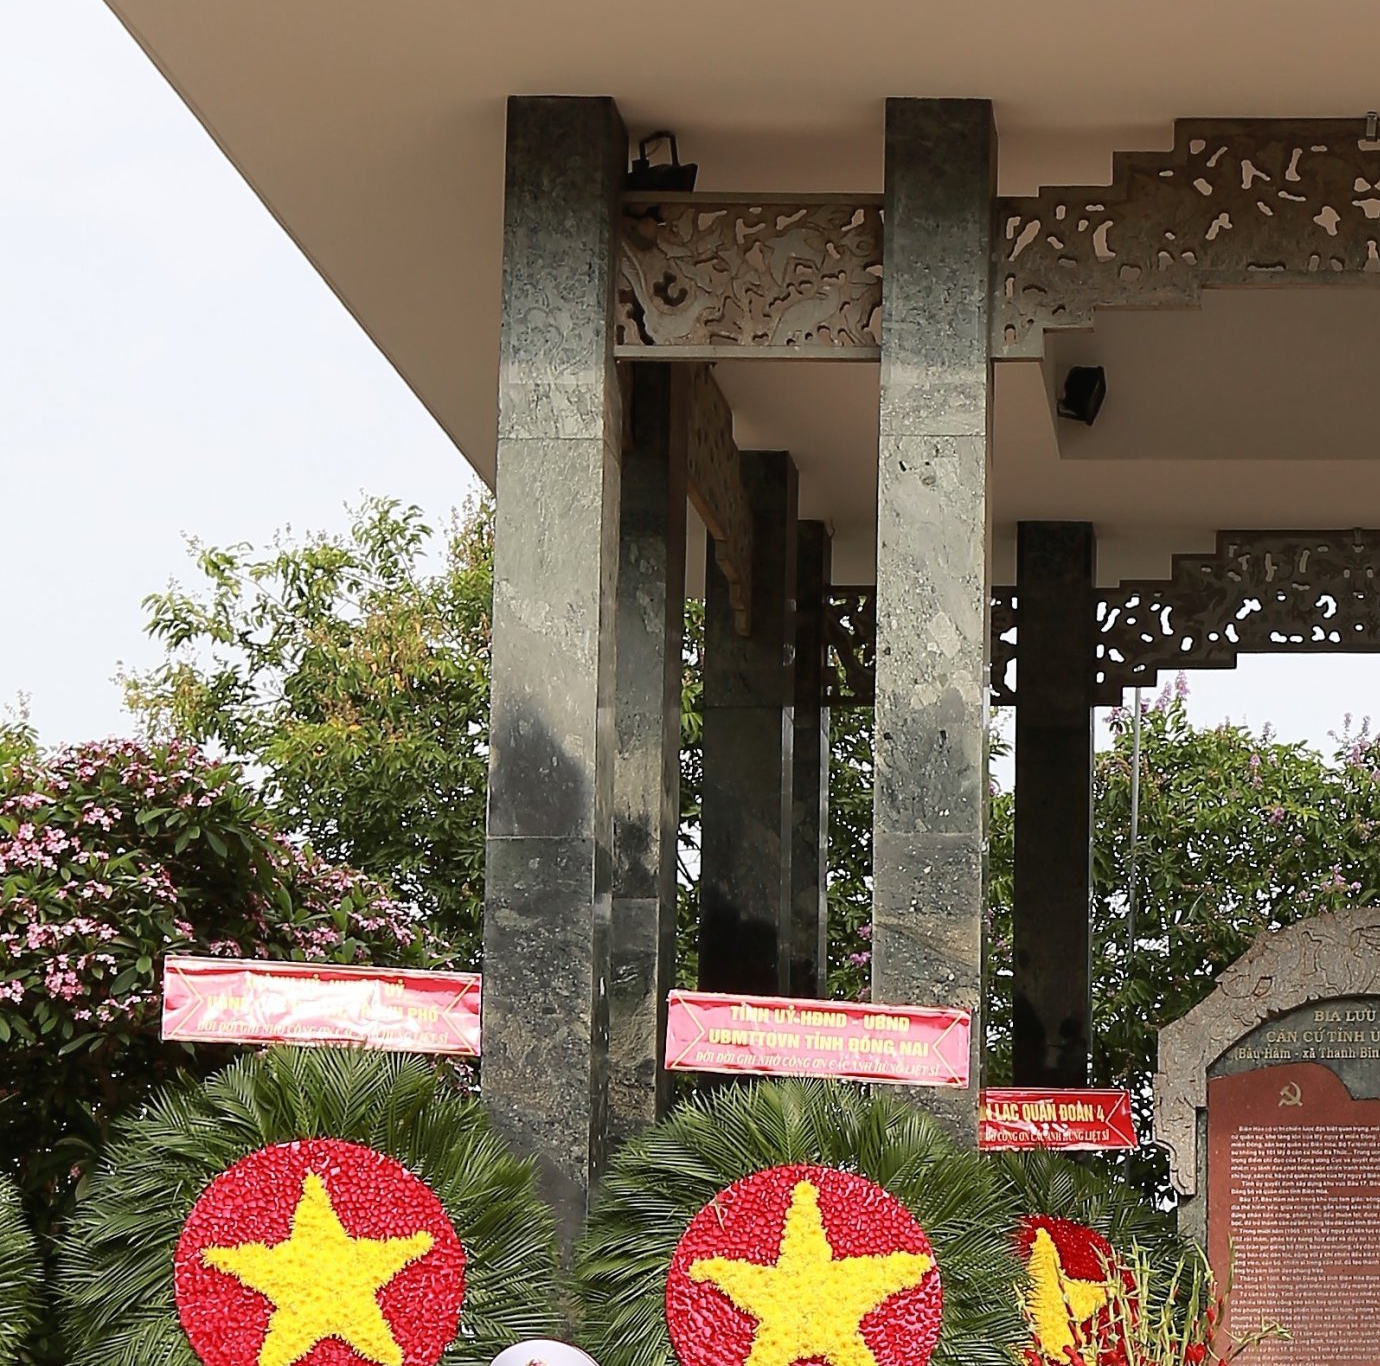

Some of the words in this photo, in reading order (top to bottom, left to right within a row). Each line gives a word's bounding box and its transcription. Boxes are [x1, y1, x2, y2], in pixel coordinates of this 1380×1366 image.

[408, 1006, 439, 1023] PHỐ
[730, 1001, 769, 1023] TỈNH
[863, 1014, 910, 1032] UBND
[1314, 1010, 1341, 1022] BIA
[1346, 1009, 1377, 1022] LƯU
[709, 1028, 799, 1050] UBMTTQVN
[805, 1031, 844, 1052] TỈNH
[848, 1034, 895, 1056] ĐỒNG
[899, 1041, 929, 1057] NAI
[1266, 1029, 1297, 1043] CĂN
[1303, 1029, 1326, 1043] CỨ
[1330, 1027, 1364, 1042] TỈNH
[696, 1050, 715, 1063] ĐỜI
[716, 1051, 735, 1065] ĐỜI
[736, 1054, 755, 1066] GHI
[782, 1055, 811, 1069] CÔNG
[1264, 1046, 1291, 1059] Hàm
[1318, 1046, 1356, 1059] Thanh
[1022, 1100, 1057, 1123] QUÂN
[1059, 1100, 1094, 1123] ĐOÀN
[1096, 1105, 1105, 1123] 4
